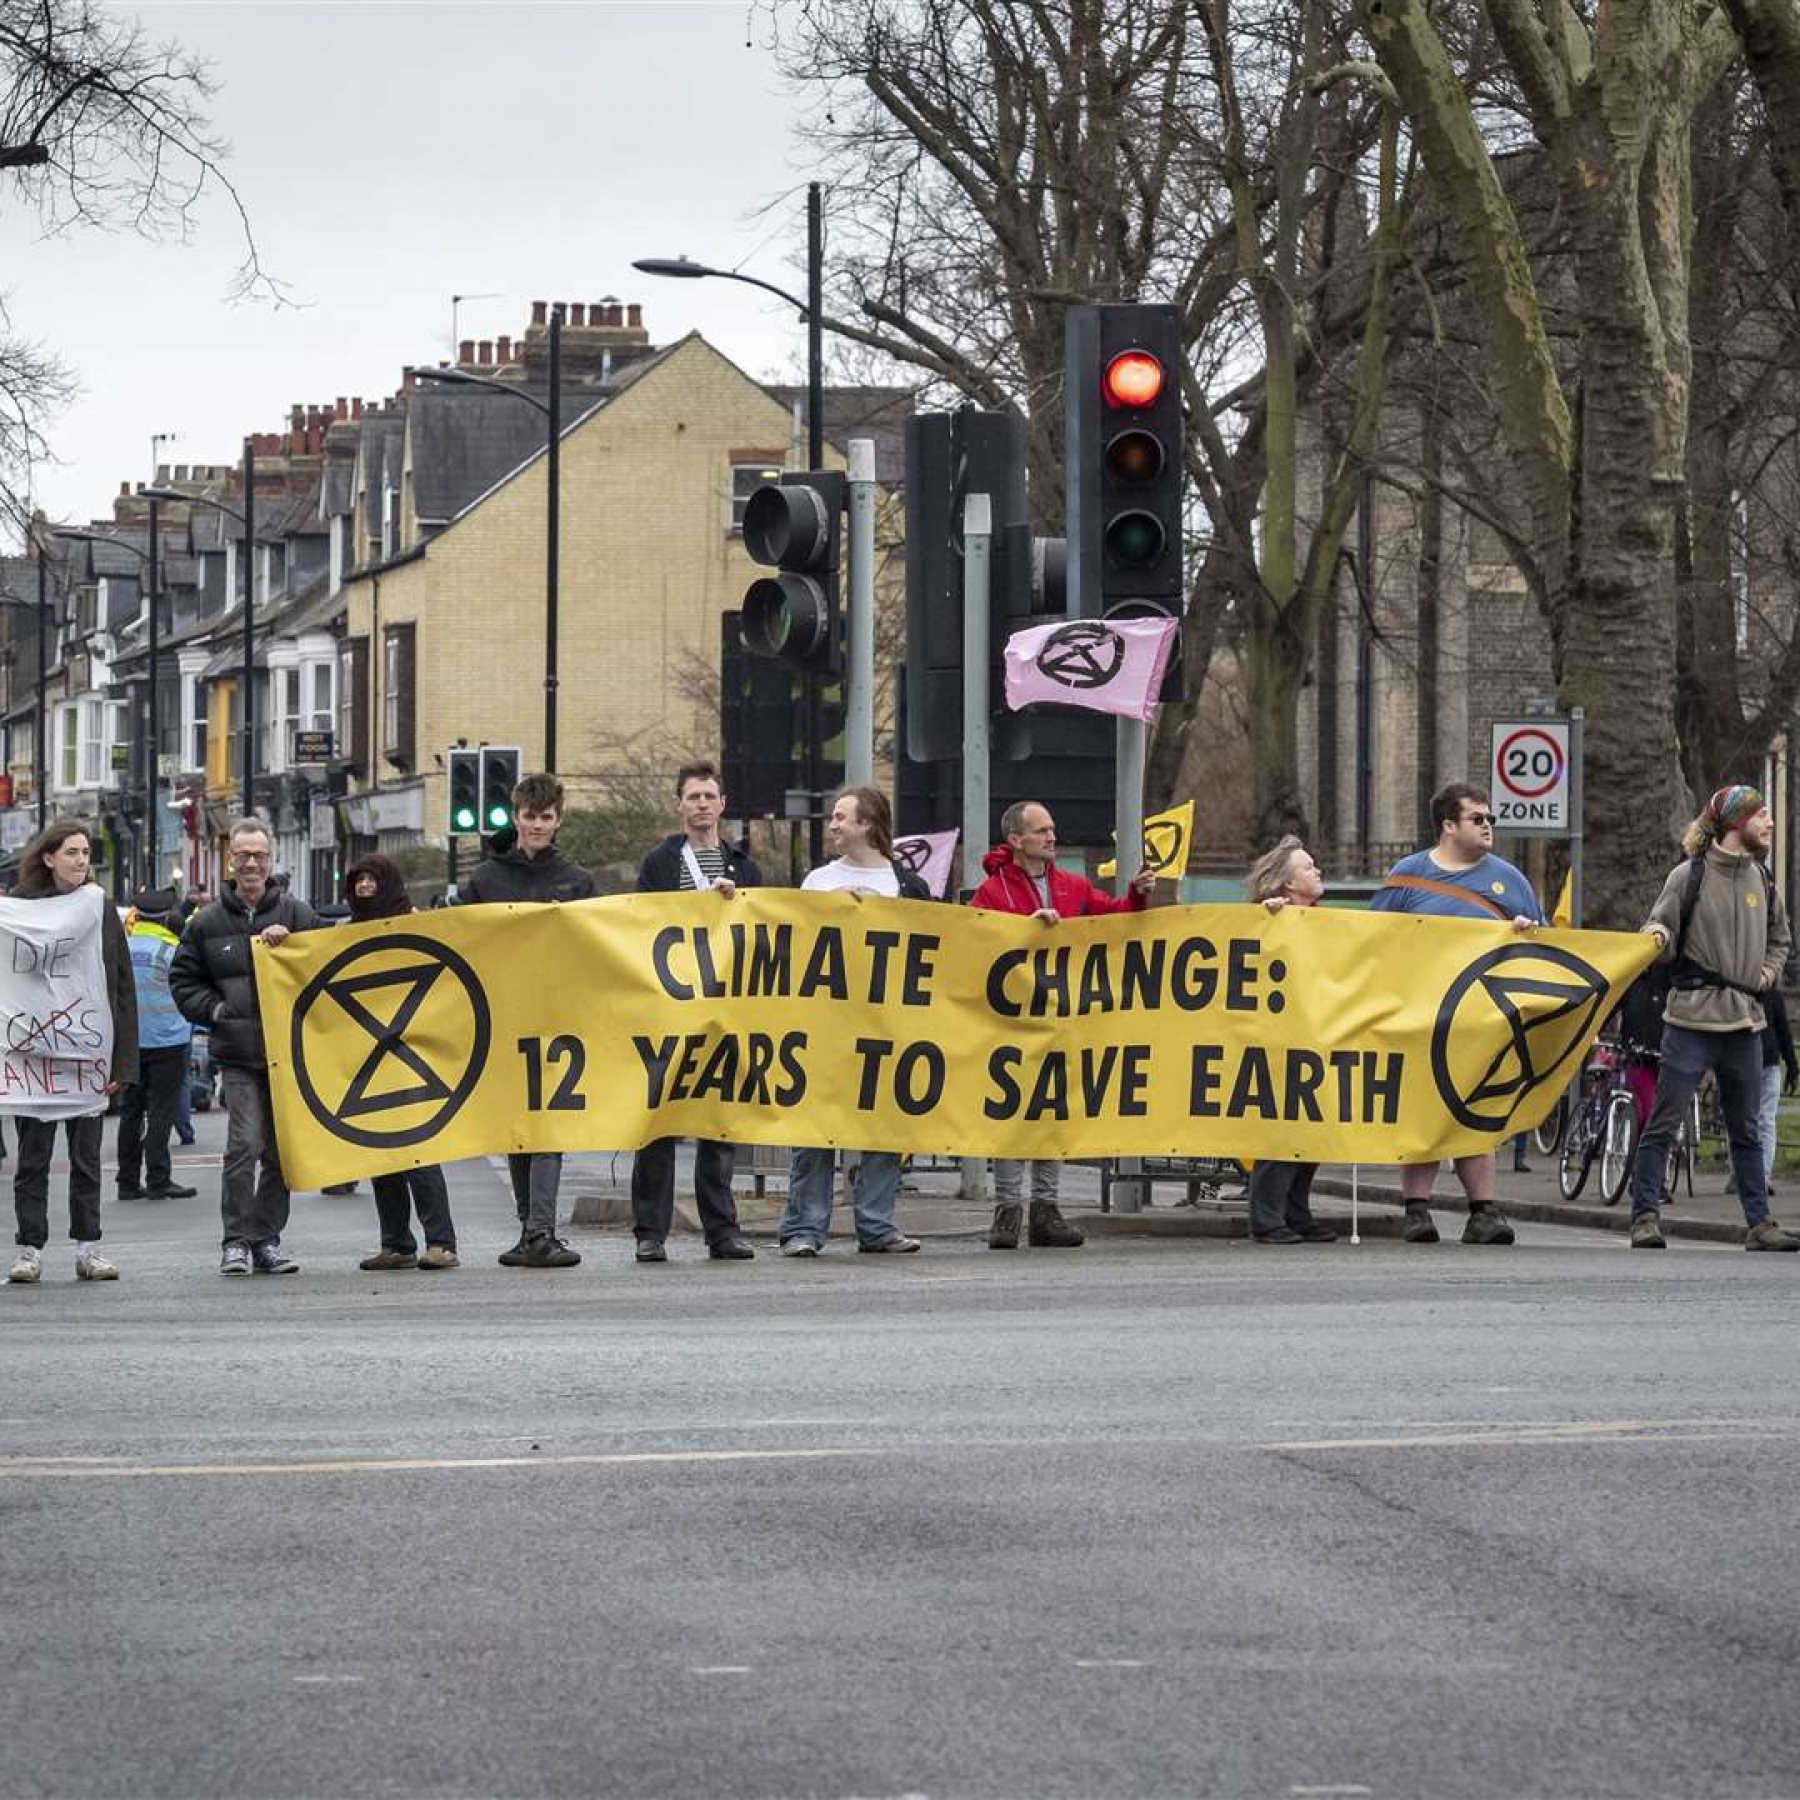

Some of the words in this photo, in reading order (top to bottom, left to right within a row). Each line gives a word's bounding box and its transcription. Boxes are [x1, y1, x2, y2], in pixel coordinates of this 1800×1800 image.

[1509, 749, 1553, 777] 20
[1499, 803, 1559, 820] ZONE
[13, 936, 76, 979] DIE
[652, 923, 941, 1006] CLIMATE
[985, 936, 1287, 1018] CHANGE:
[6, 1008, 103, 1053] CARS
[517, 1034, 586, 1111] 12
[631, 1031, 808, 1111] YEARS
[854, 1037, 946, 1116] TO
[983, 1044, 1151, 1121] SAVE
[1188, 1044, 1404, 1124] EARTH
